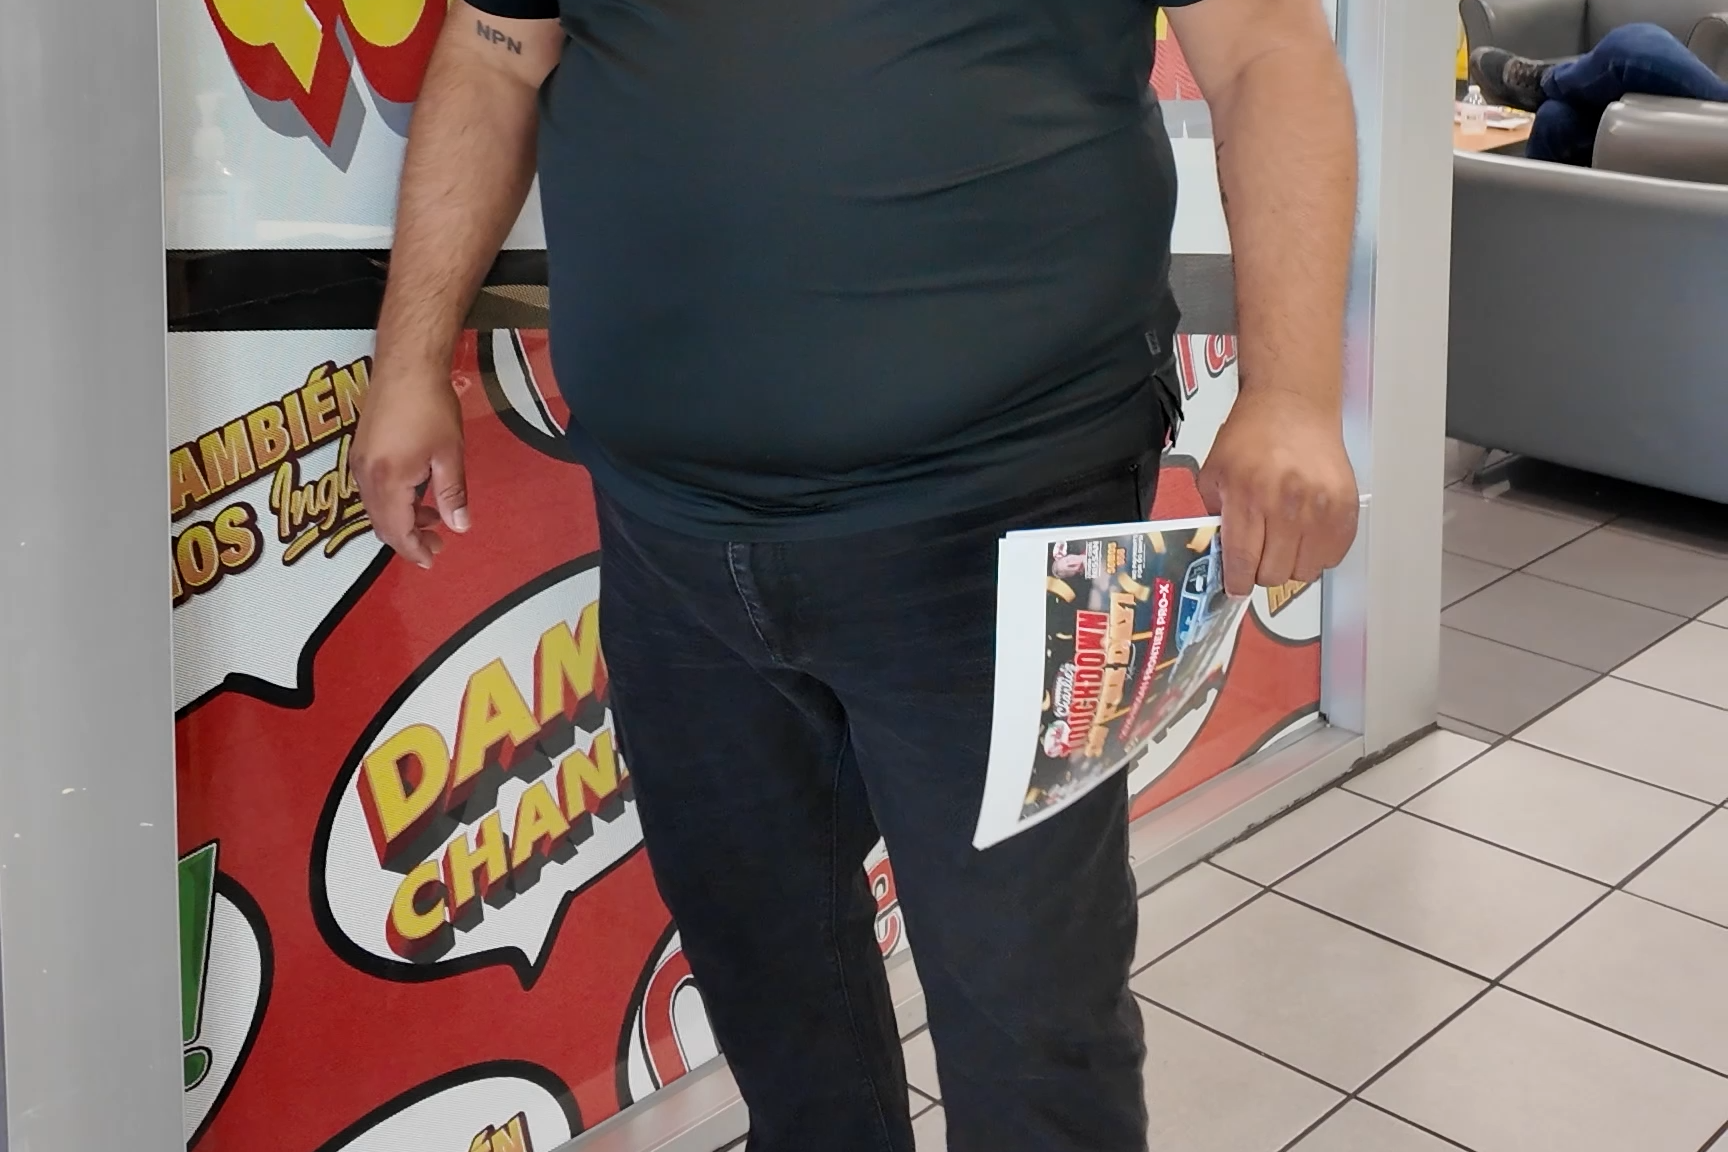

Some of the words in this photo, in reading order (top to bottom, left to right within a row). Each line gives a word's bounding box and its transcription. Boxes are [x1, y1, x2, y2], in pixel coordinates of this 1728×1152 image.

[475, 19, 522, 55] NPN
[1060, 609, 1111, 756] TOUCHDOWN
[1143, 626, 1165, 681] FRONTIER
[1156, 583, 1170, 626] PRO-X
[387, 728, 630, 946] CHAN
